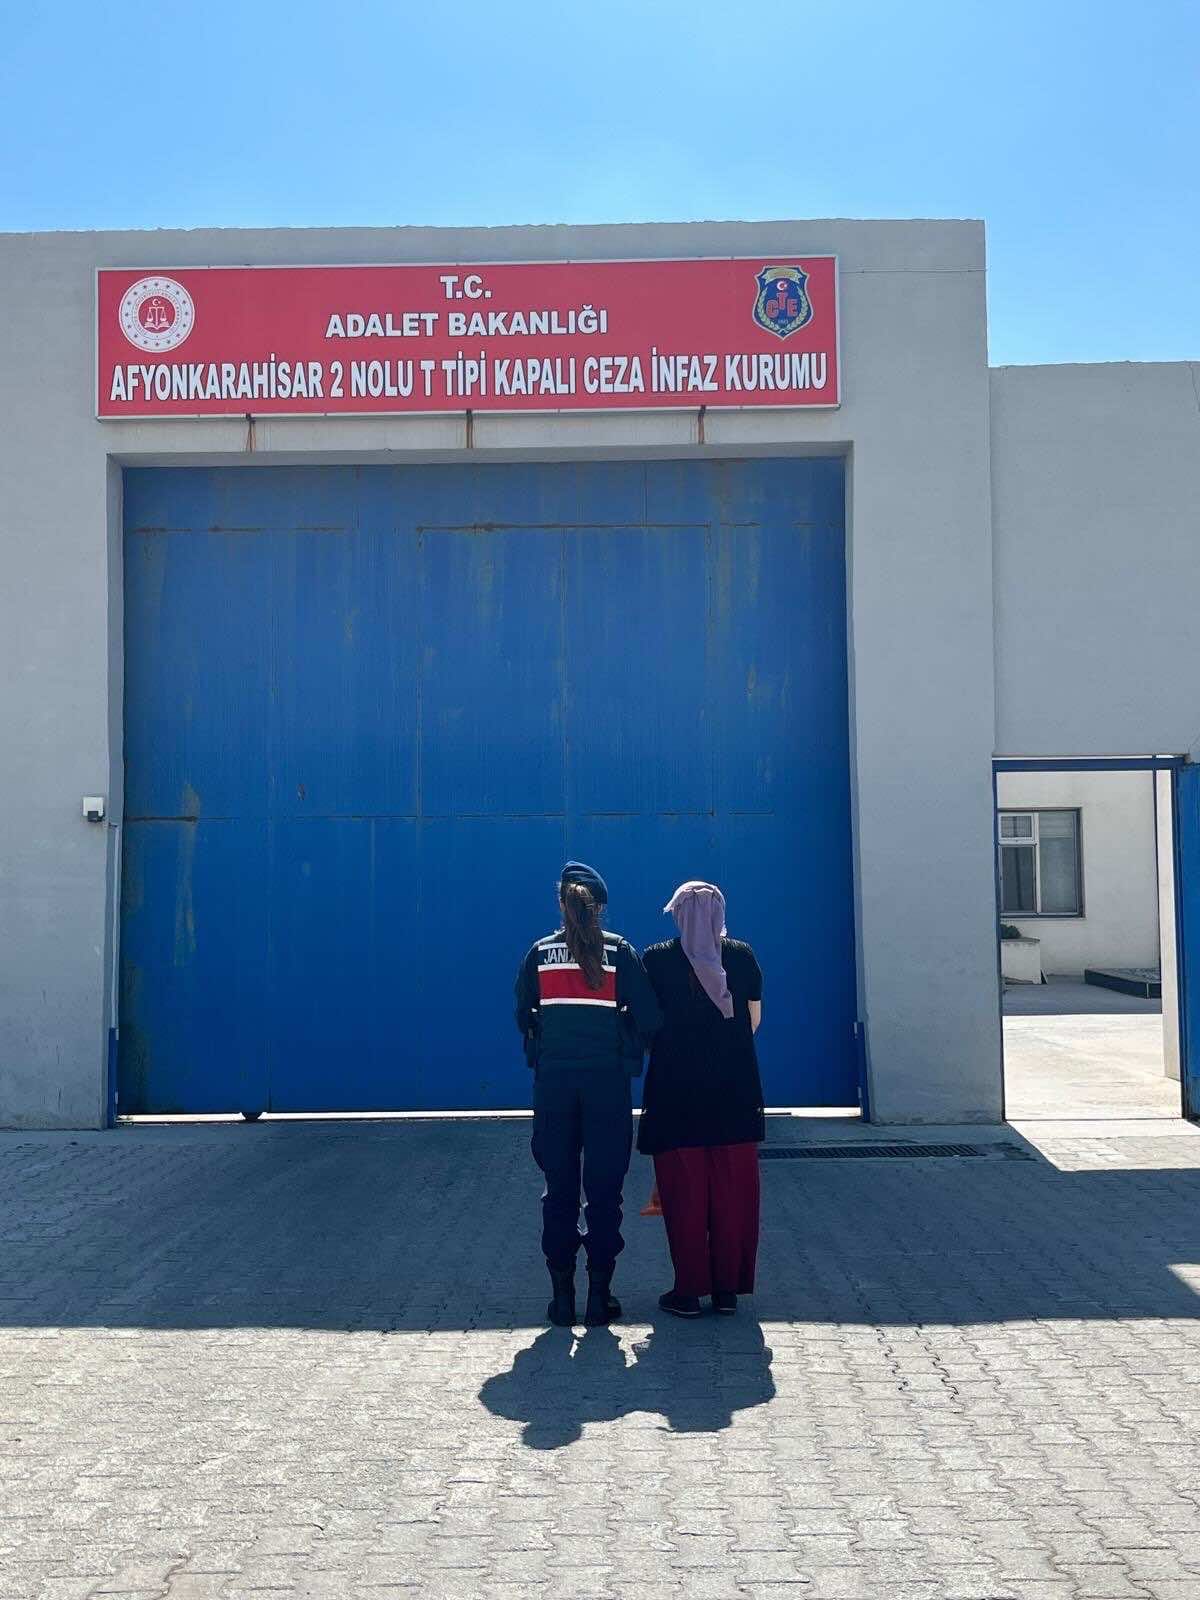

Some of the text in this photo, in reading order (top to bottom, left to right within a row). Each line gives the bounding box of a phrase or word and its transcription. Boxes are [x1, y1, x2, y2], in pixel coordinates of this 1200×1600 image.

[440, 275, 492, 299] T.C.
[325, 304, 608, 338] ADALET BAKANLIĞI
[110, 346, 827, 401] AFYONKARAHİSAR 2 NOLU T TİPİ KAPALI CEZA İNFAZ KURUMU
[544, 949, 608, 965] JANA
